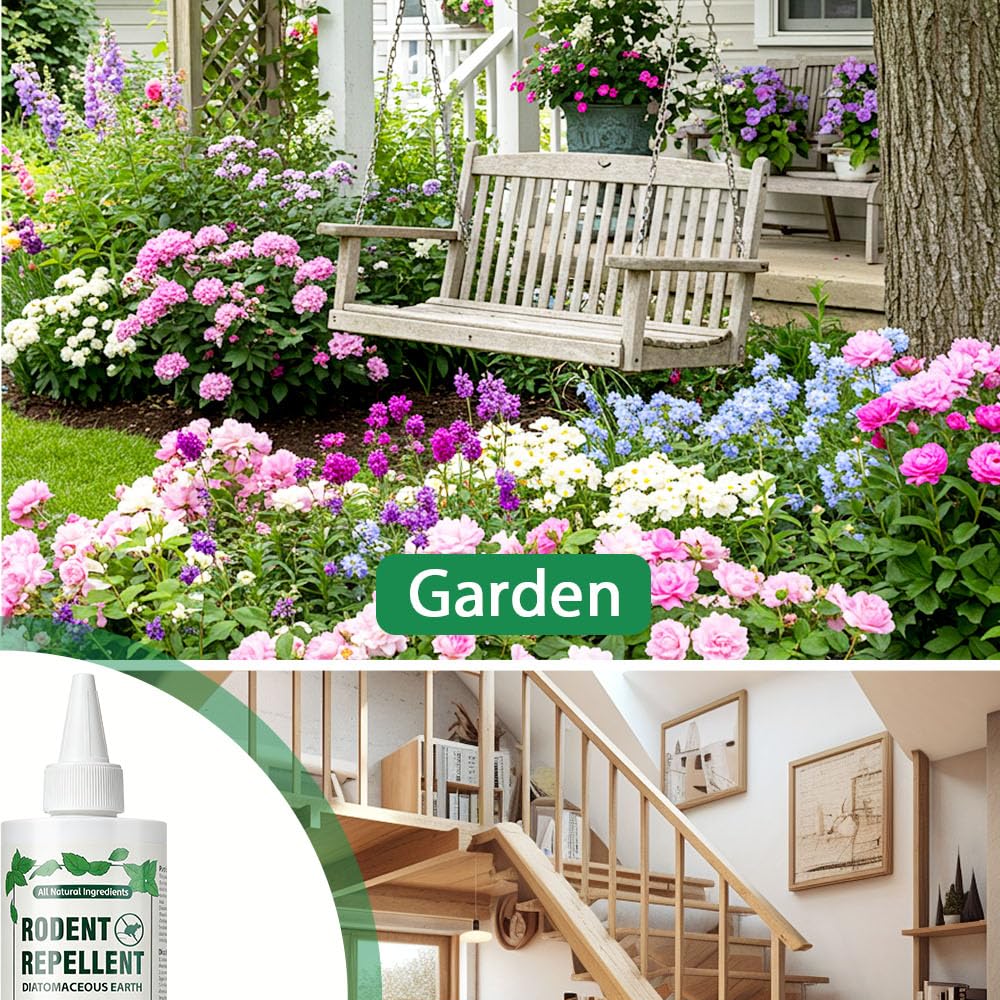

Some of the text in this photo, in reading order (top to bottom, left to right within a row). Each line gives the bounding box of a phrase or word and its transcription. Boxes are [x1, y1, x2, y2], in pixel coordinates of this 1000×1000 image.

[38, 887, 129, 898] All Natural Ingredients
[22, 917, 111, 941] RODENT
[22, 951, 144, 975] REPELLENT
[23, 982, 143, 993] DIATOMACEOUS EARTH
